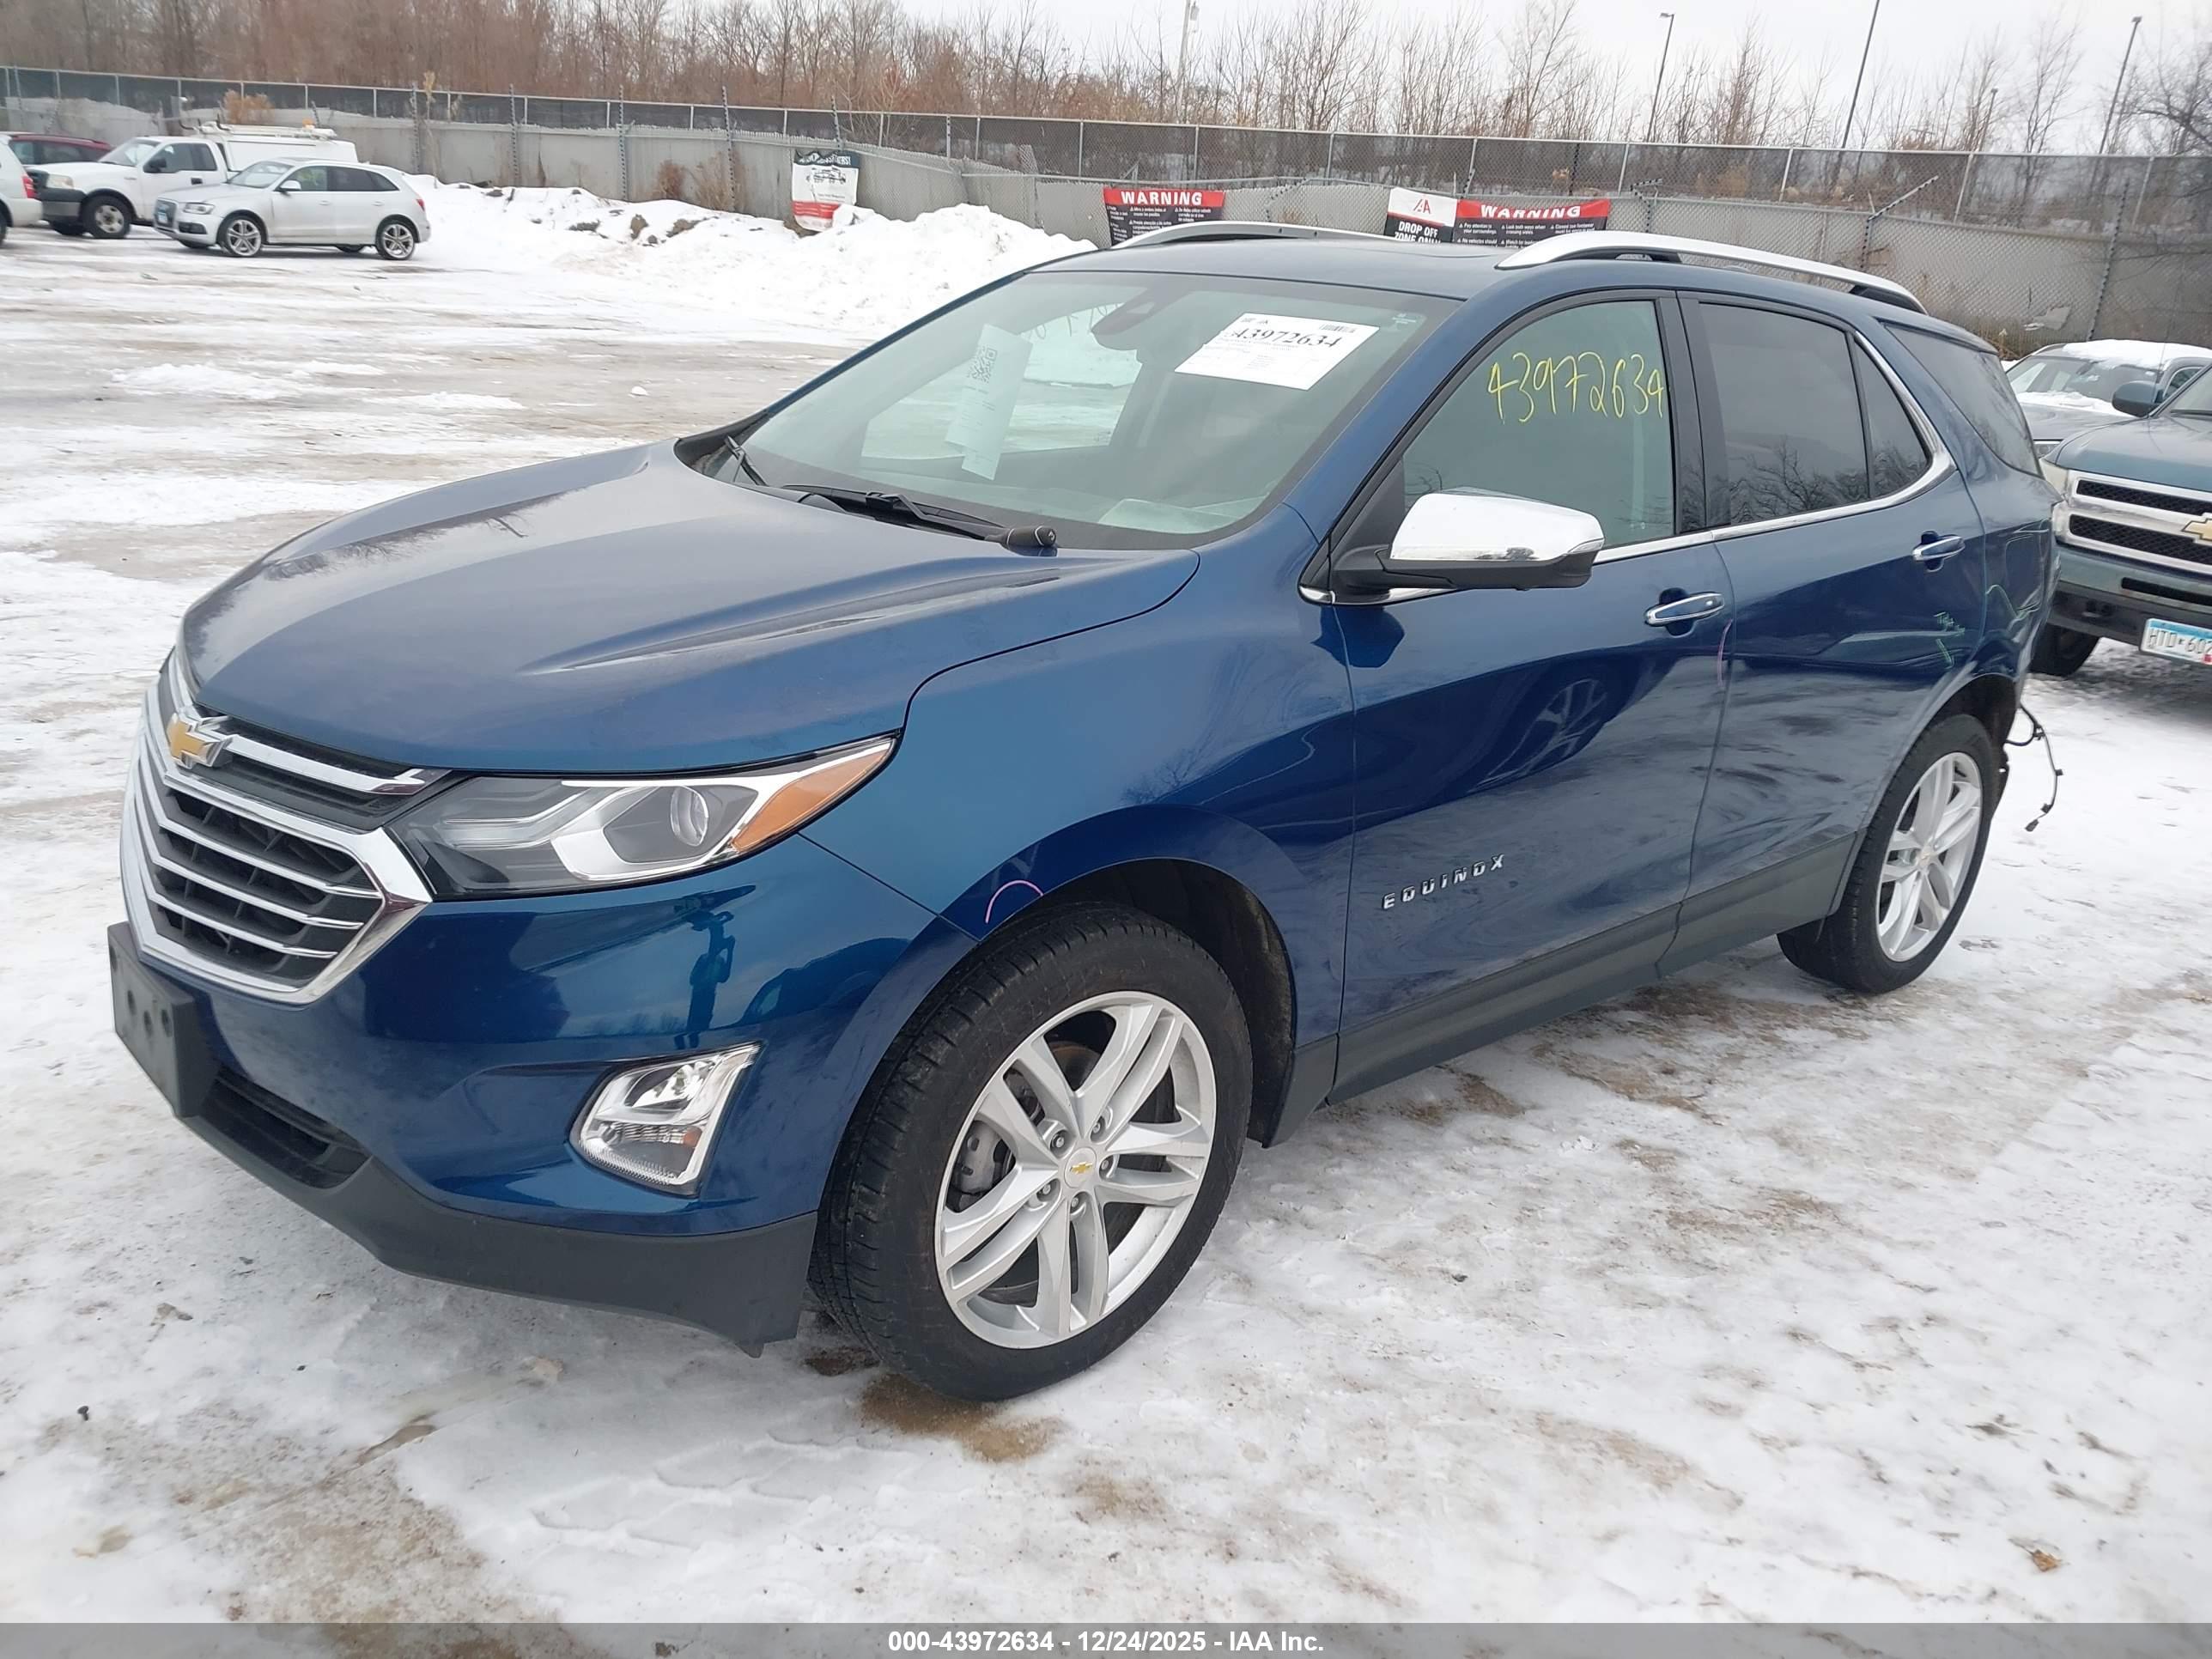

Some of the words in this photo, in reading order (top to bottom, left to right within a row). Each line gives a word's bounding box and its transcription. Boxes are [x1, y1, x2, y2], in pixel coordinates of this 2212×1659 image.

[1121, 191, 1202, 205] WARNING
[1480, 204, 1581, 219] WARNING
[1395, 231, 1417, 241] ZONE
[1398, 221, 1423, 234] DROP
[1424, 227, 1438, 238] OFF
[1230, 328, 1342, 348] 43972634
[1488, 351, 1664, 422] 43972634
[1382, 854, 1504, 910] EQUINOX
